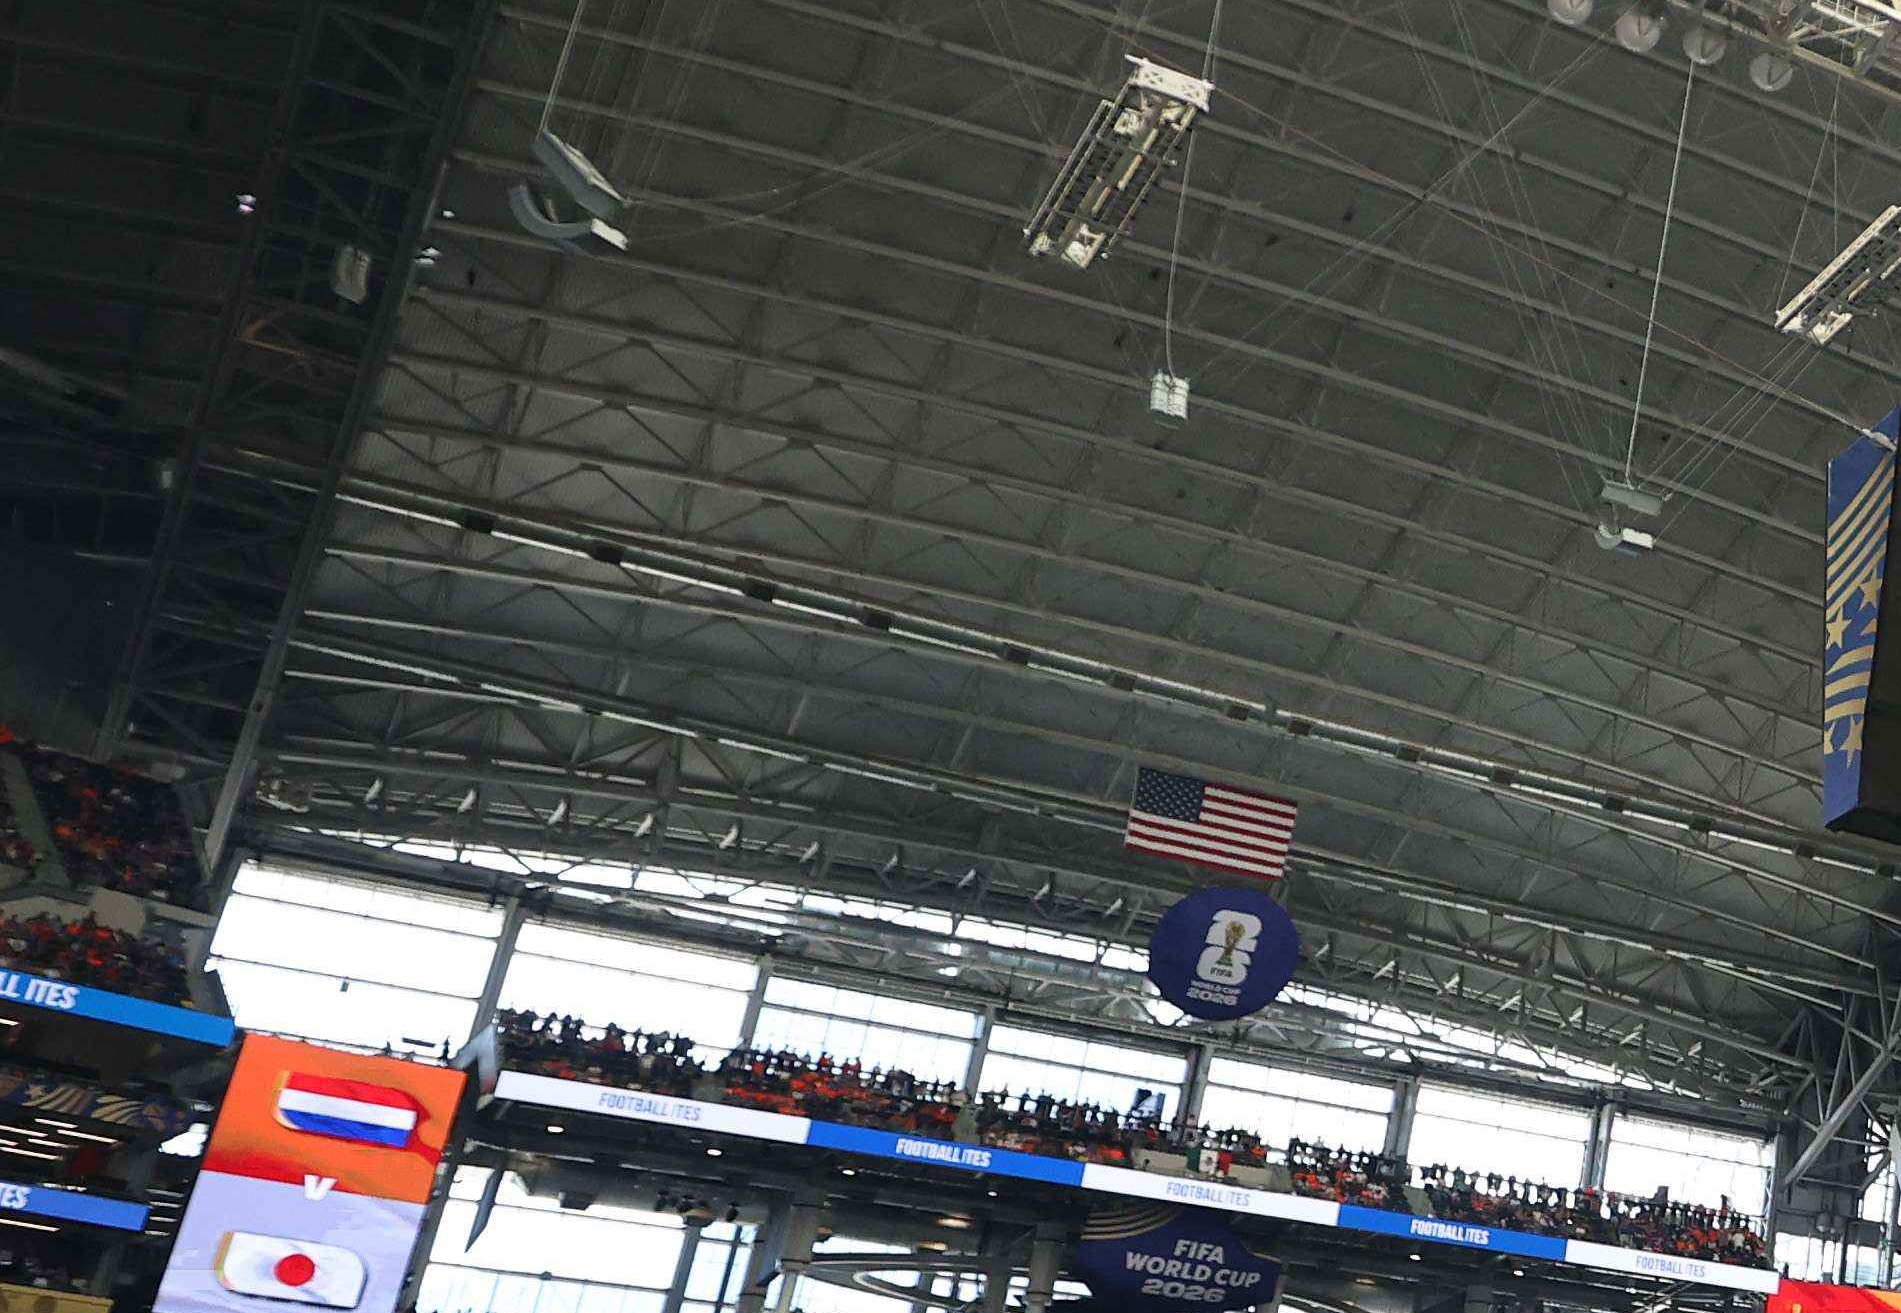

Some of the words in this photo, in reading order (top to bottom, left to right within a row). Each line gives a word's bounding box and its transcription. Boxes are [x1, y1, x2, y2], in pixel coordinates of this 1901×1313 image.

[599, 1093, 669, 1116] FOOTBALL
[896, 1138, 962, 1163] FOOTBALL
[1167, 1182, 1224, 1203] FOOTBALL
[1410, 1219, 1466, 1242] FOOTBALL
[1173, 1239, 1225, 1264] FIFA
[1125, 1251, 1212, 1282] WORLD
[1213, 1268, 1262, 1288] CUP
[1636, 1256, 1682, 1276] FOOTBALL
[1141, 1278, 1226, 1303] 2026
